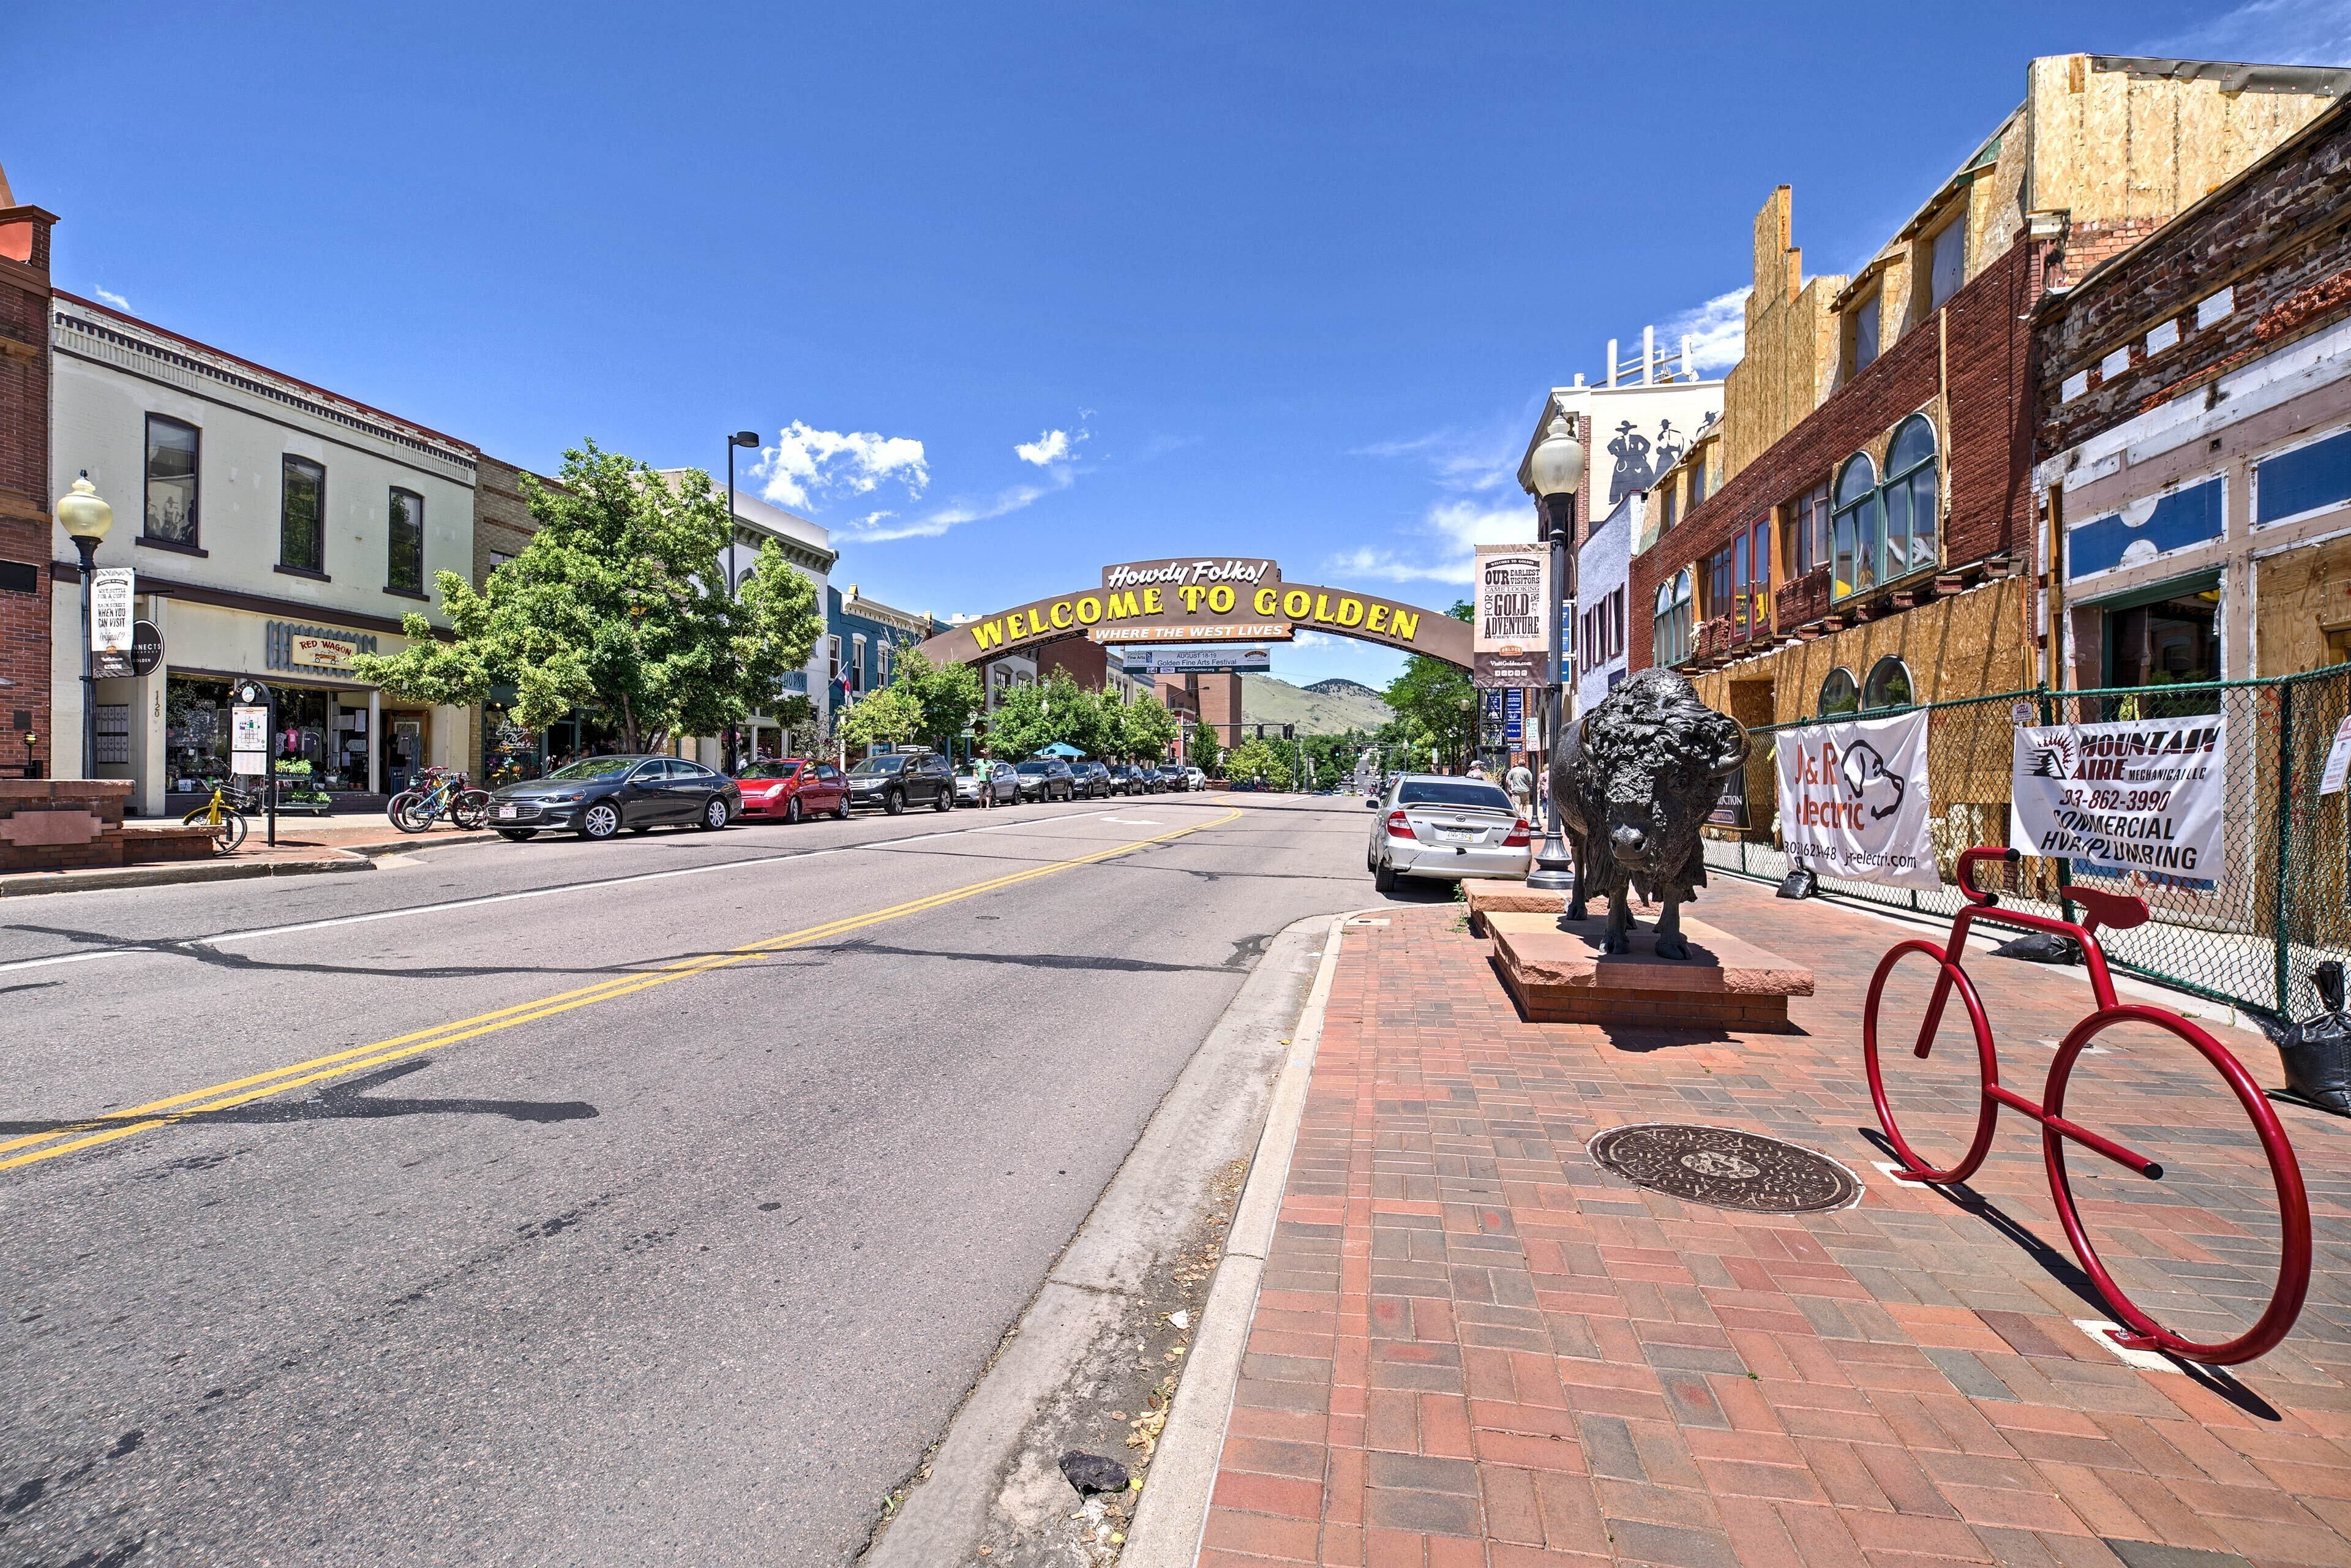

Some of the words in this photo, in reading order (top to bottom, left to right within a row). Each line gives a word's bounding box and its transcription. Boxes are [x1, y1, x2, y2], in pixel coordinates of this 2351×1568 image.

[1108, 561, 1189, 588] Howdy
[1191, 560, 1268, 584] Folks!
[1485, 569, 1510, 585] OUR
[1494, 593, 1529, 616] GOLD
[1531, 593, 1540, 602] AND
[98, 608, 113, 617] WHEN
[115, 608, 126, 617] YOU
[98, 618, 108, 628] CAN
[110, 618, 126, 628] VISIT
[970, 587, 1164, 651] WELCOME
[1179, 585, 1236, 613] TO
[1253, 587, 1420, 642] GOLDEN
[100, 632, 125, 644] Original?
[1095, 628, 1153, 639] WHERE
[1155, 628, 1185, 638] THE
[1190, 626, 1233, 637] WEST
[1238, 625, 1283, 636] LIVES
[1484, 616, 1539, 639] ADVENTURE
[299, 640, 318, 650] RED
[321, 640, 352, 656] WAGON
[496, 720, 531, 740] Baby
[2079, 726, 2221, 758] MOUNTAIN
[1794, 744, 1803, 785] J
[1806, 756, 1819, 785] &
[1823, 742, 1839, 786] R
[2070, 759, 2128, 781] AIRE
[2186, 767, 2207, 780] LLC
[2053, 809, 2175, 841] COMMERCIAL
